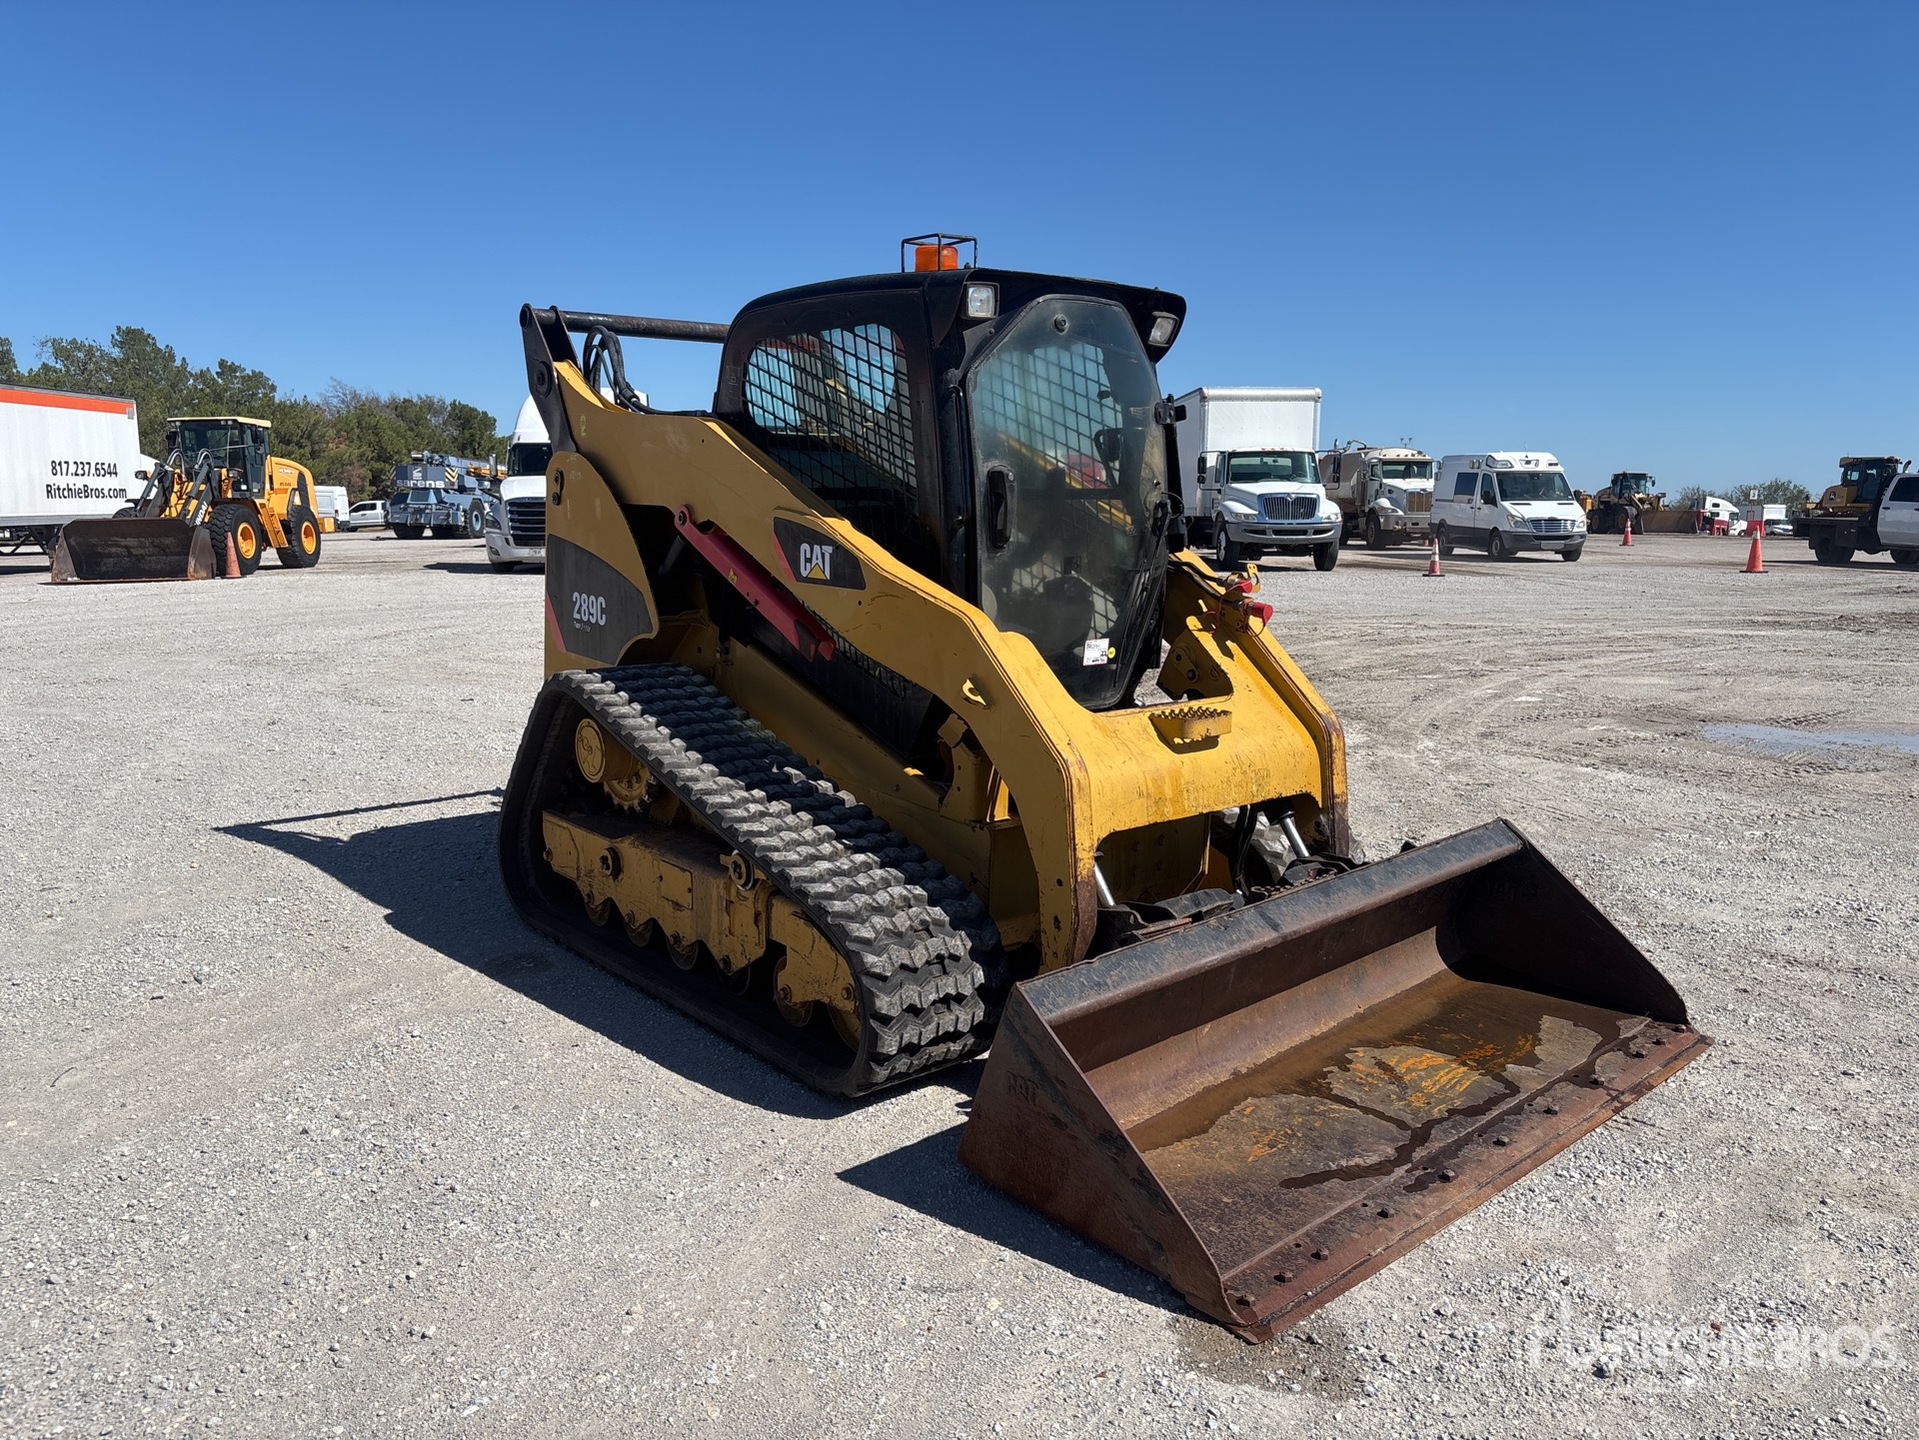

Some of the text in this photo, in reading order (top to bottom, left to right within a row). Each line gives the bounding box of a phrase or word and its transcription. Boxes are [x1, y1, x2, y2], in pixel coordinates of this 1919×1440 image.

[51, 460, 118, 478] 817.237.6544
[46, 483, 127, 499] RitchieBros.com
[396, 479, 445, 488] sarens
[800, 543, 832, 580] CAT
[572, 591, 606, 626] 289C
